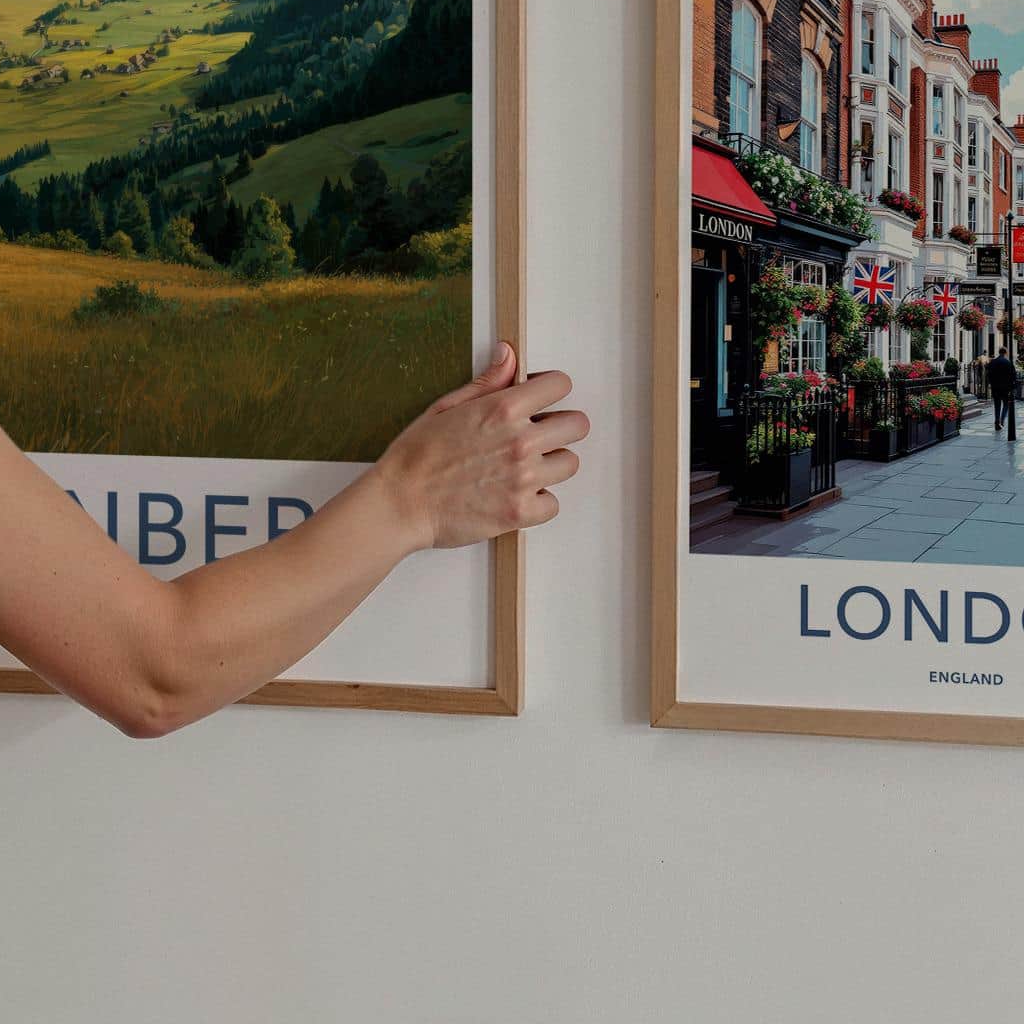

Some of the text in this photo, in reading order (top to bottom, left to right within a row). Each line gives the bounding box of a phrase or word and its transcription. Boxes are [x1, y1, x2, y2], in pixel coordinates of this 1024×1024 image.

[699, 213, 753, 242] LONDON
[800, 584, 1024, 644] LOND
[929, 670, 1004, 686] ENGLAND
